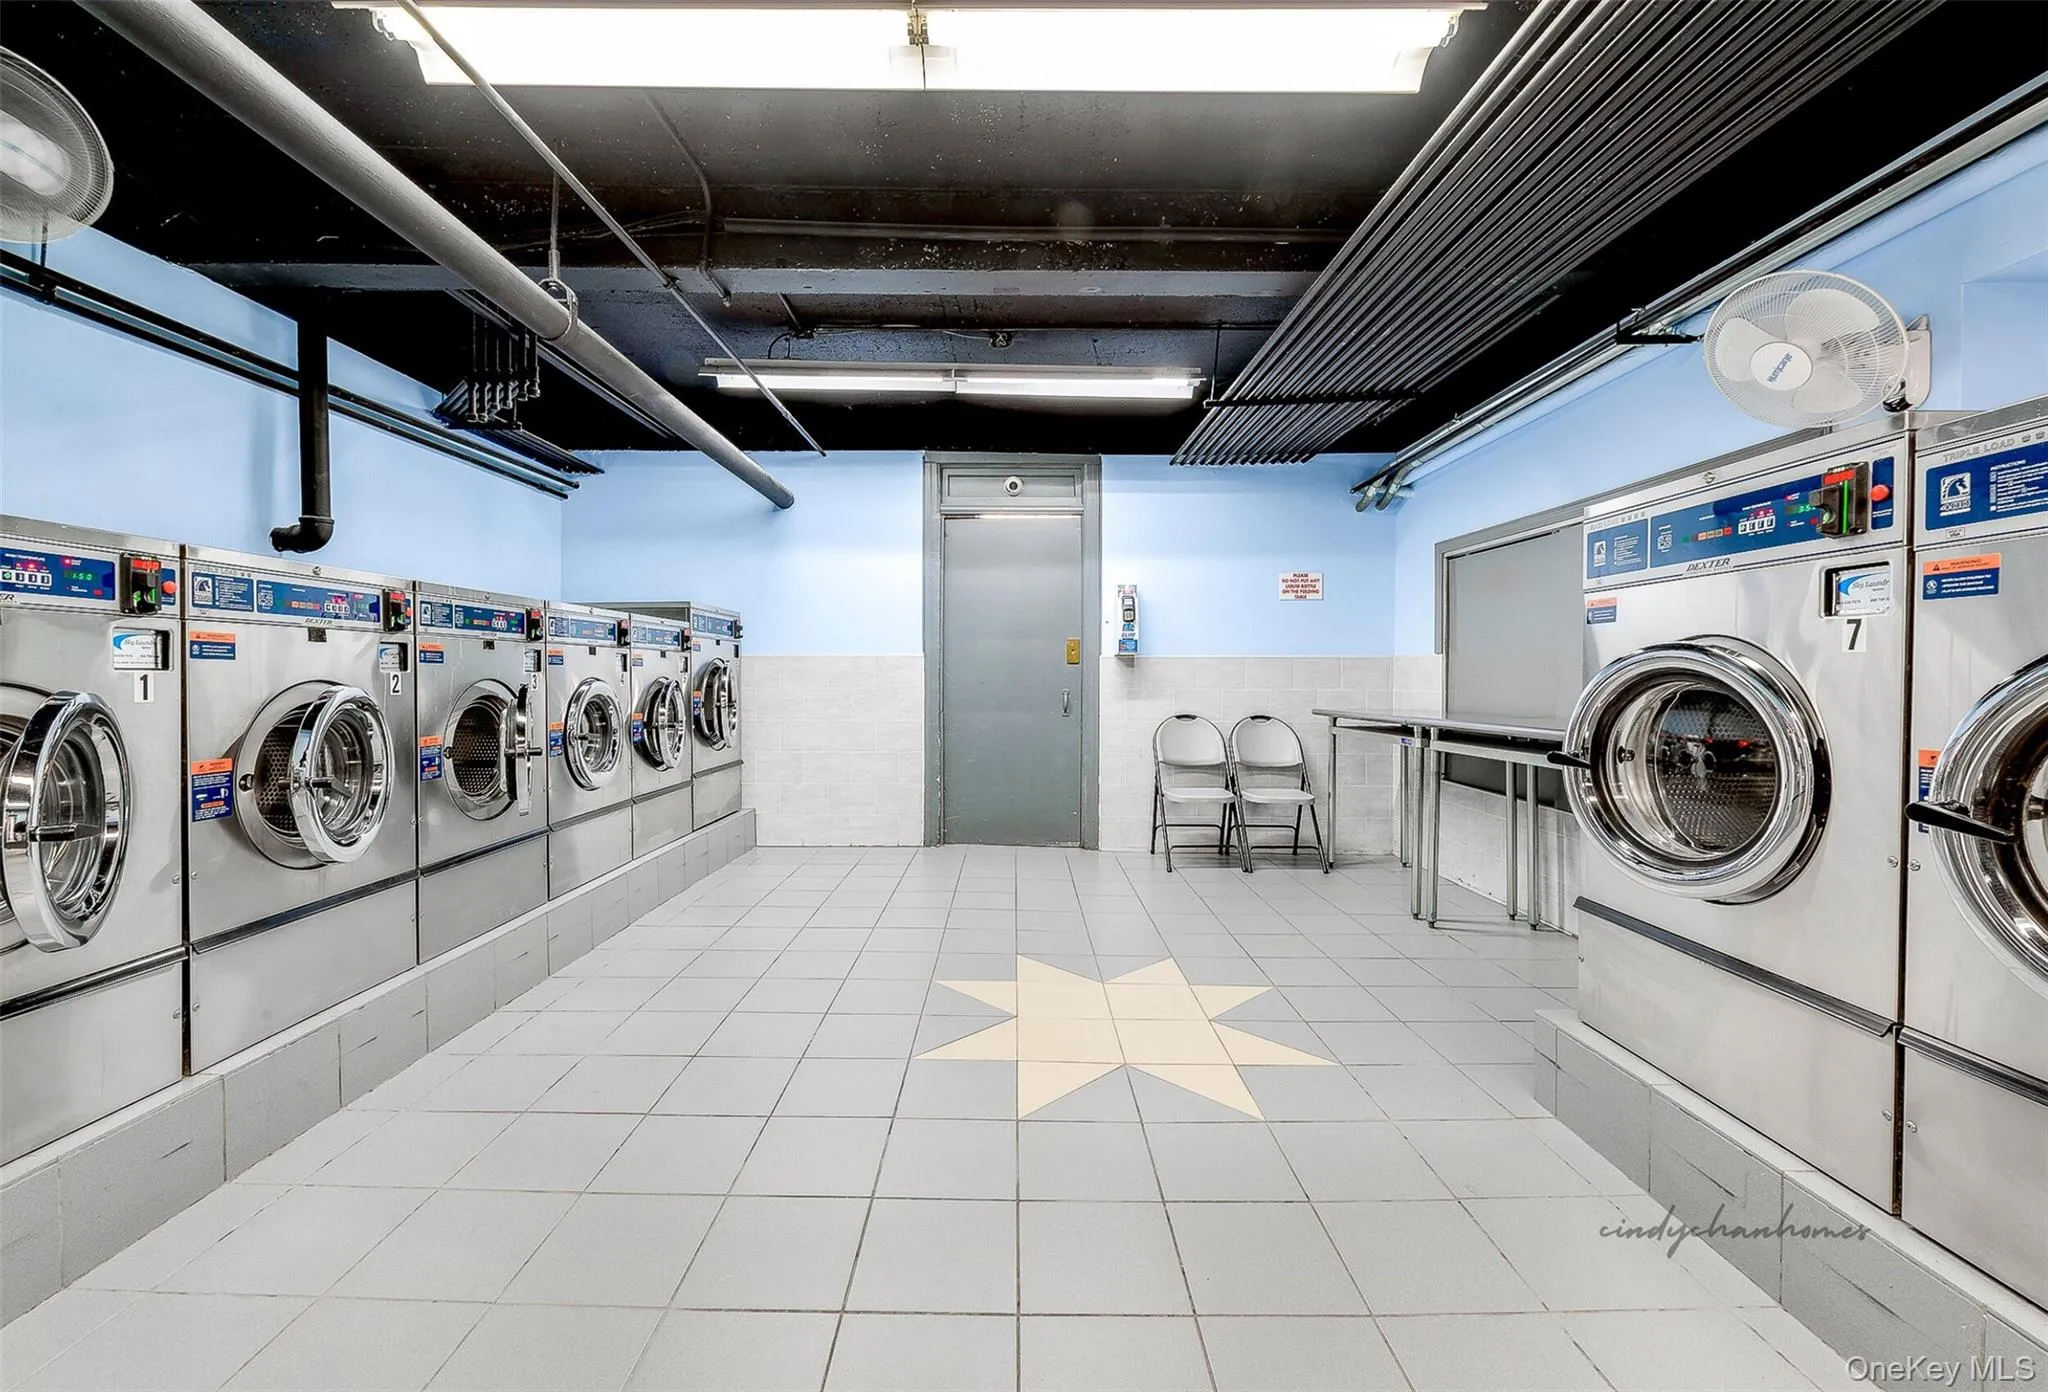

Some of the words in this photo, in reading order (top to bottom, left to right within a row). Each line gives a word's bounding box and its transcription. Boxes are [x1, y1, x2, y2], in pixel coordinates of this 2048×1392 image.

[1943, 448, 1979, 461] TRIPLE
[1984, 438, 2015, 451] LOAD
[1686, 557, 1731, 572] DEXTER
[1846, 619, 1862, 650] 7
[139, 674, 149, 701] 1
[391, 674, 400, 694] 2
[532, 674, 538, 690] 3
